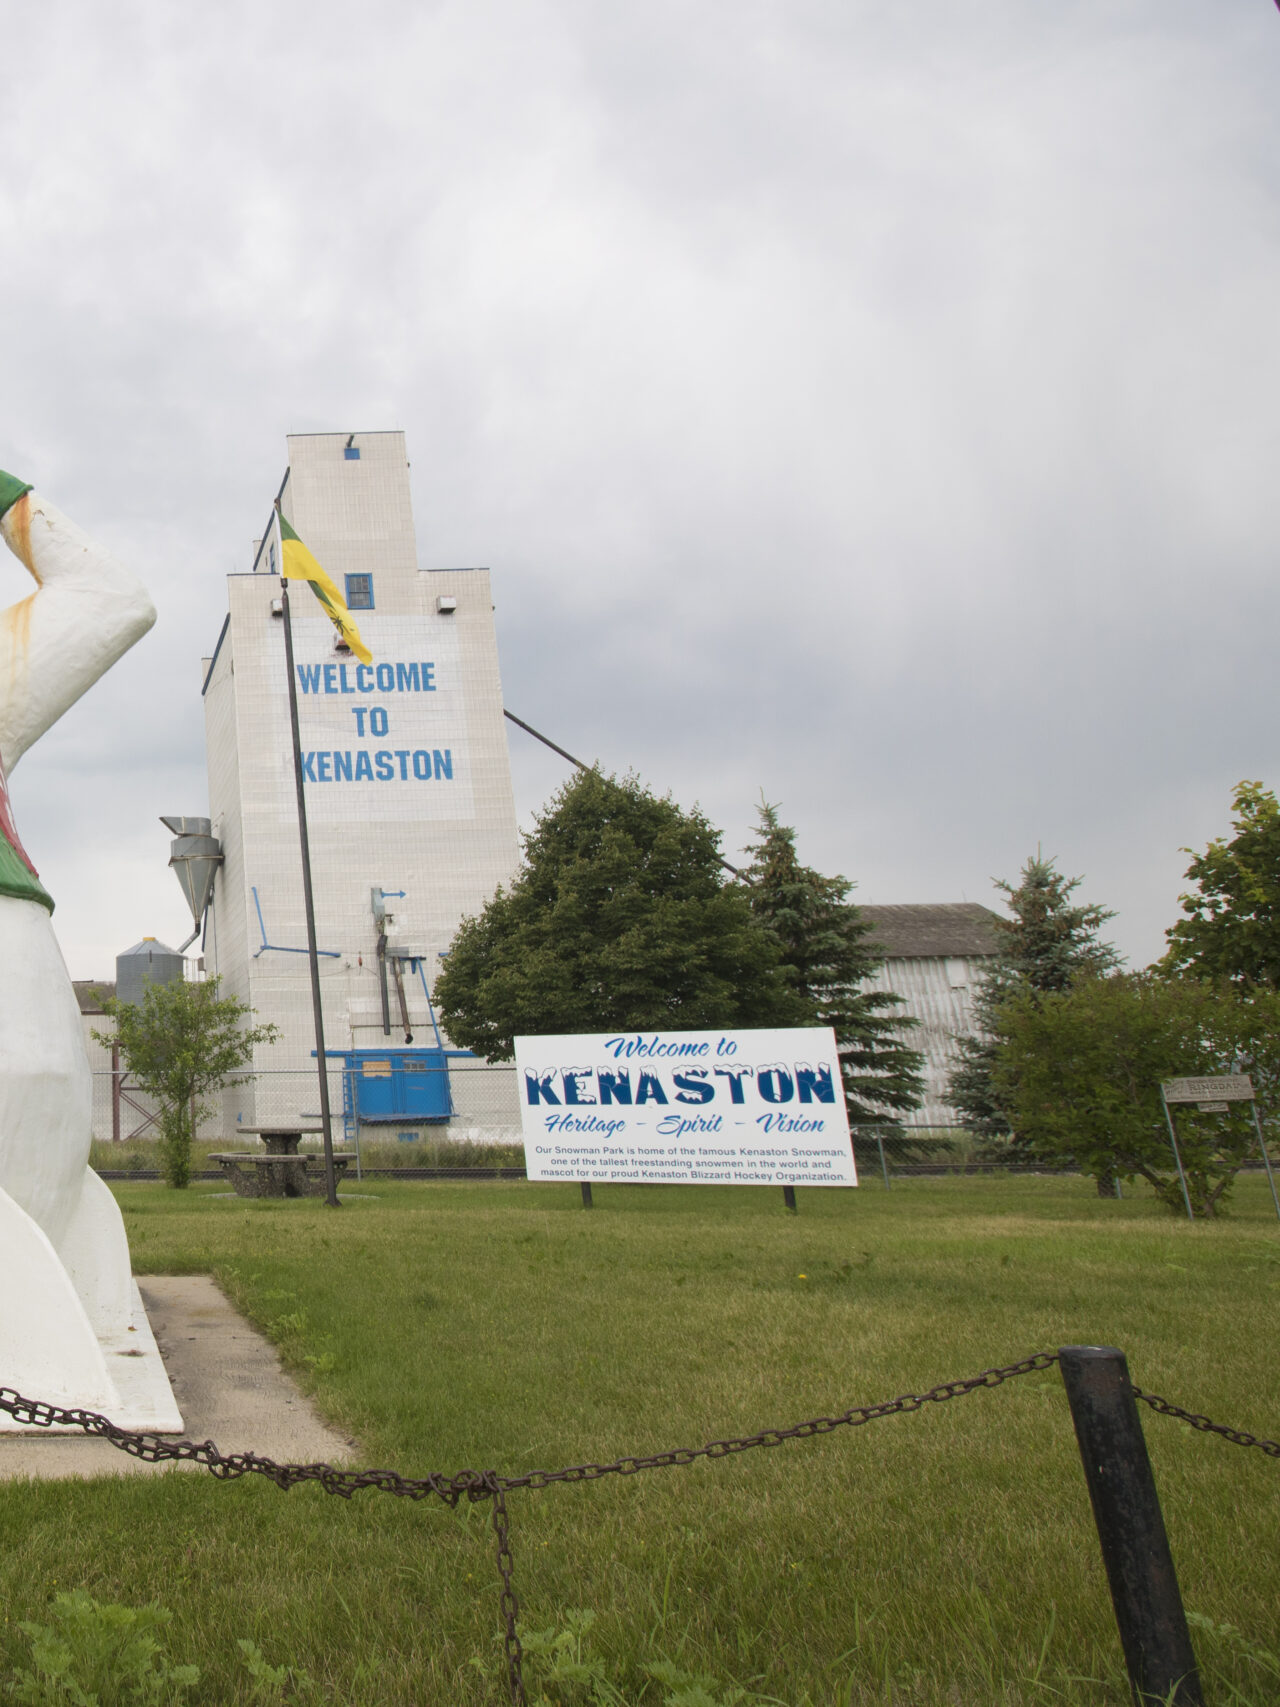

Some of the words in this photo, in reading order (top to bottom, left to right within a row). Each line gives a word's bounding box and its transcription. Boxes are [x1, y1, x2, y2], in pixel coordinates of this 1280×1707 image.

[297, 662, 437, 694] WELCOME
[351, 706, 389, 737] TO
[300, 749, 454, 782] KENASTON
[604, 1035, 710, 1059] Welcome
[716, 1036, 738, 1057] to
[524, 1062, 836, 1106] KENASTON
[544, 1112, 626, 1139] Heritage
[656, 1113, 723, 1138] Spirit
[756, 1111, 826, 1134] Vision
[535, 1145, 552, 1154] Our
[554, 1146, 600, 1155] Snowman
[603, 1146, 624, 1155] Park
[627, 1147, 635, 1155] is
[638, 1147, 665, 1155] home
[667, 1147, 677, 1155] of
[680, 1147, 696, 1155] the
[699, 1147, 736, 1156] famous
[740, 1148, 788, 1156] Kenaston
[791, 1148, 847, 1157] Snowman,
[570, 1158, 580, 1166] of
[582, 1158, 597, 1166] the
[600, 1158, 628, 1166] tallest
[631, 1159, 692, 1169] freestanding
[747, 1160, 757, 1168] in
[759, 1160, 776, 1168] the
[779, 1160, 809, 1168] world
[811, 1160, 832, 1168] and
[540, 1168, 575, 1177] mascot
[576, 1169, 589, 1177] for
[610, 1170, 639, 1179] proud
[641, 1170, 688, 1178] Kenaston
[690, 1170, 731, 1179] Blizzard
[734, 1171, 772, 1181] Hockey
[775, 1171, 847, 1182] Organization.
